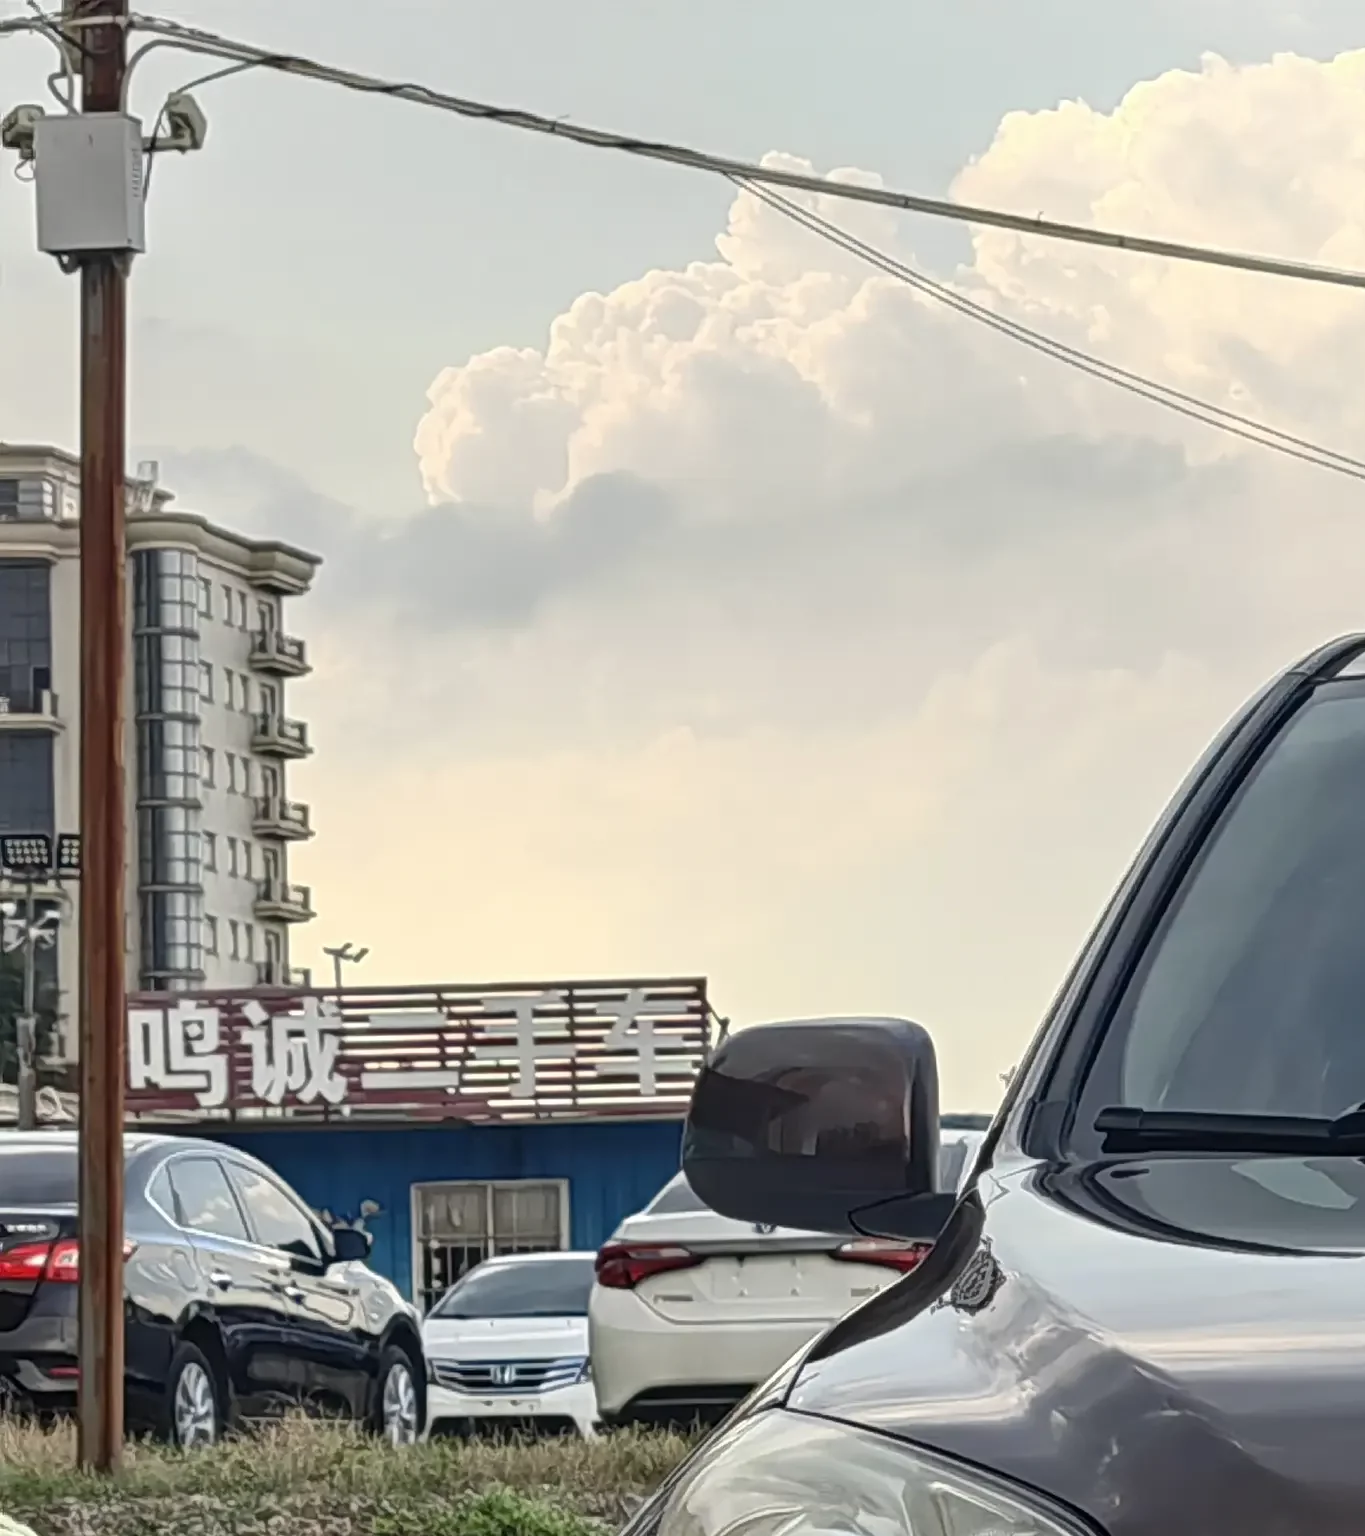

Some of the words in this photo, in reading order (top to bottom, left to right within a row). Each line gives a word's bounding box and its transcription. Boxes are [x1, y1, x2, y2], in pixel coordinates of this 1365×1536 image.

[128, 989, 690, 1107] 鸣诚二手车
